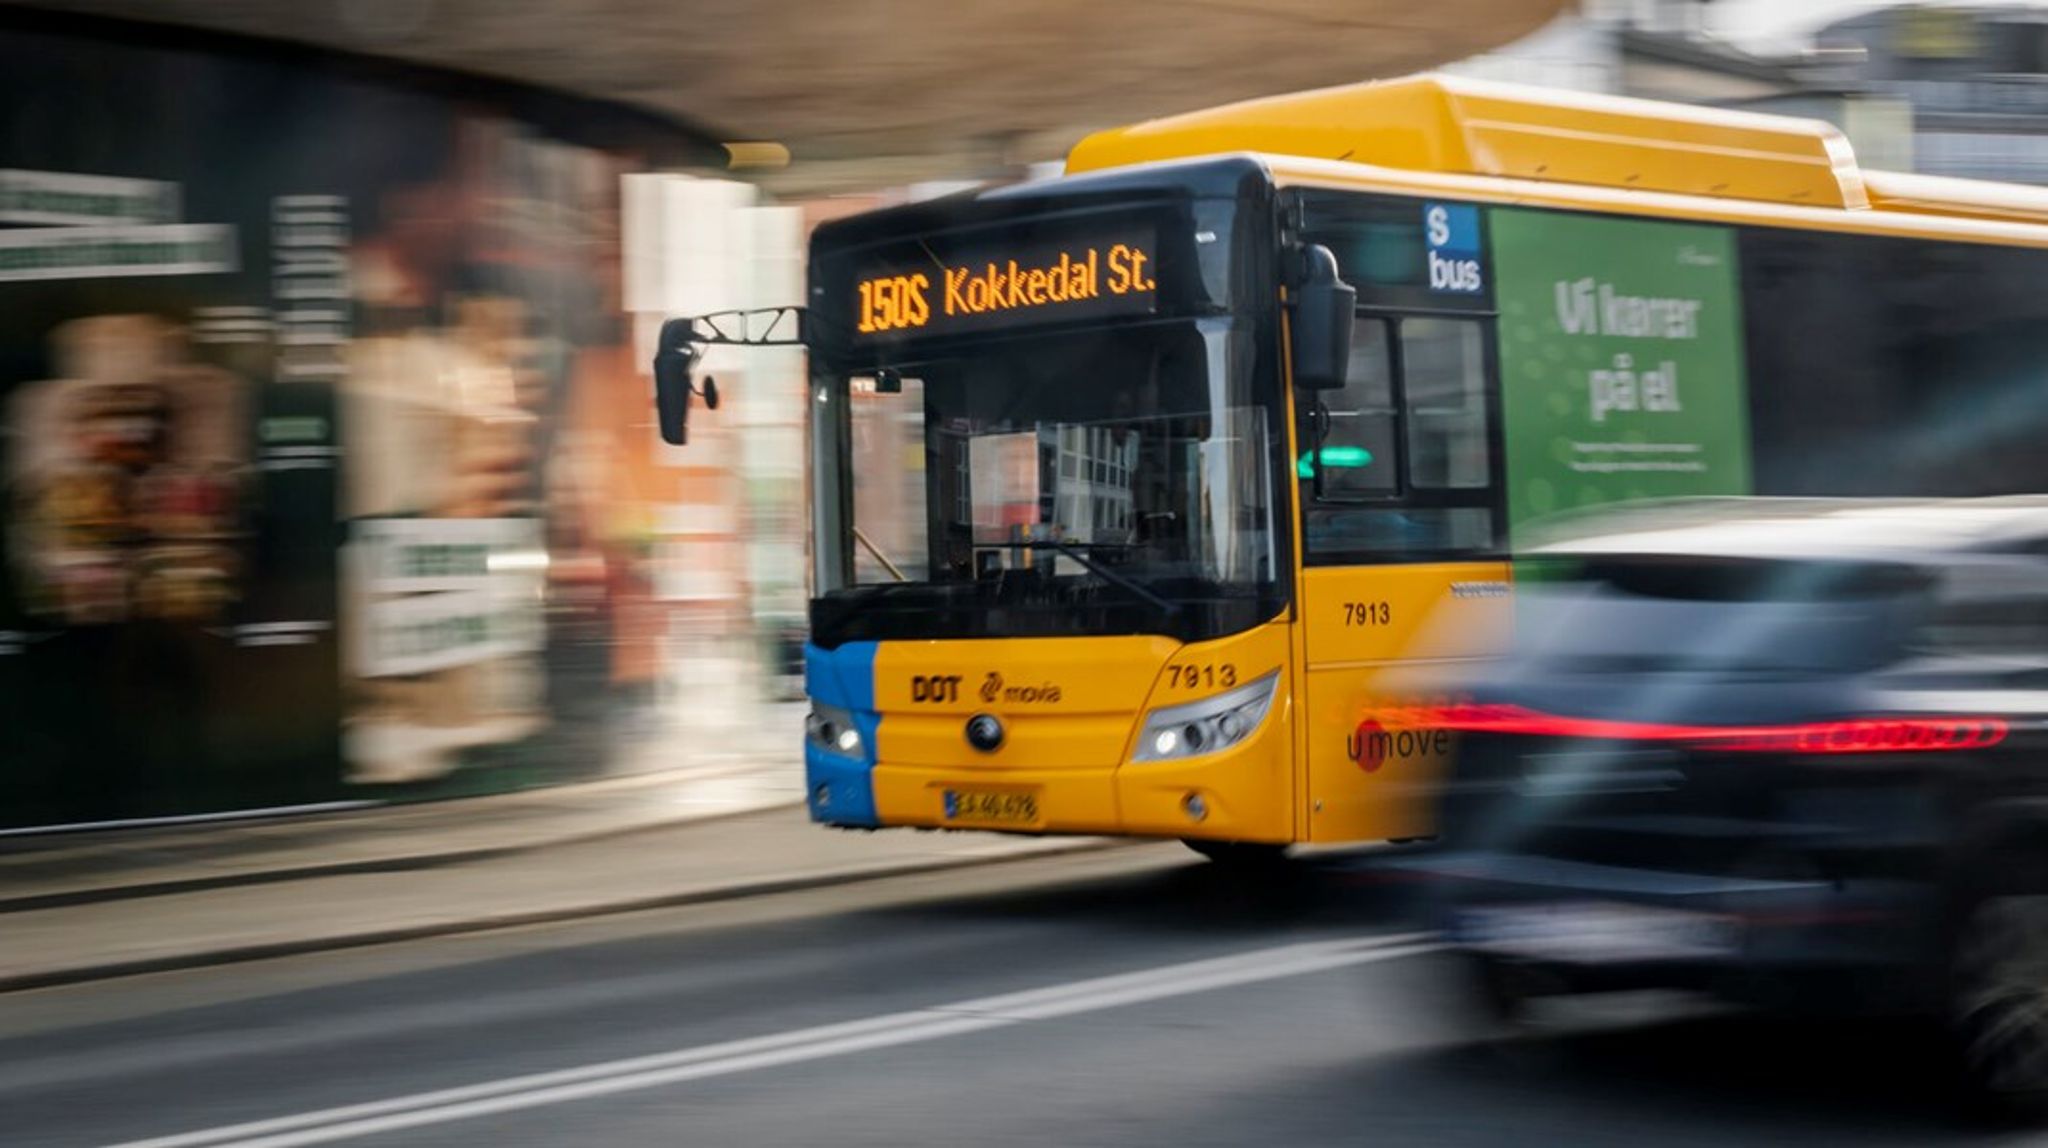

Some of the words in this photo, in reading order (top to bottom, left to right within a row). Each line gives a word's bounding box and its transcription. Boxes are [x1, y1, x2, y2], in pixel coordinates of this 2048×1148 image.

[1426, 205, 1450, 246] S
[1429, 249, 1482, 292] bus
[857, 273, 929, 333] 150S
[944, 247, 1099, 316] Kokkedal
[1107, 243, 1157, 294] St.
[1343, 602, 1391, 627] 7913
[911, 675, 963, 703] DOT
[1004, 683, 1062, 703] movia
[1167, 664, 1237, 690] 7913
